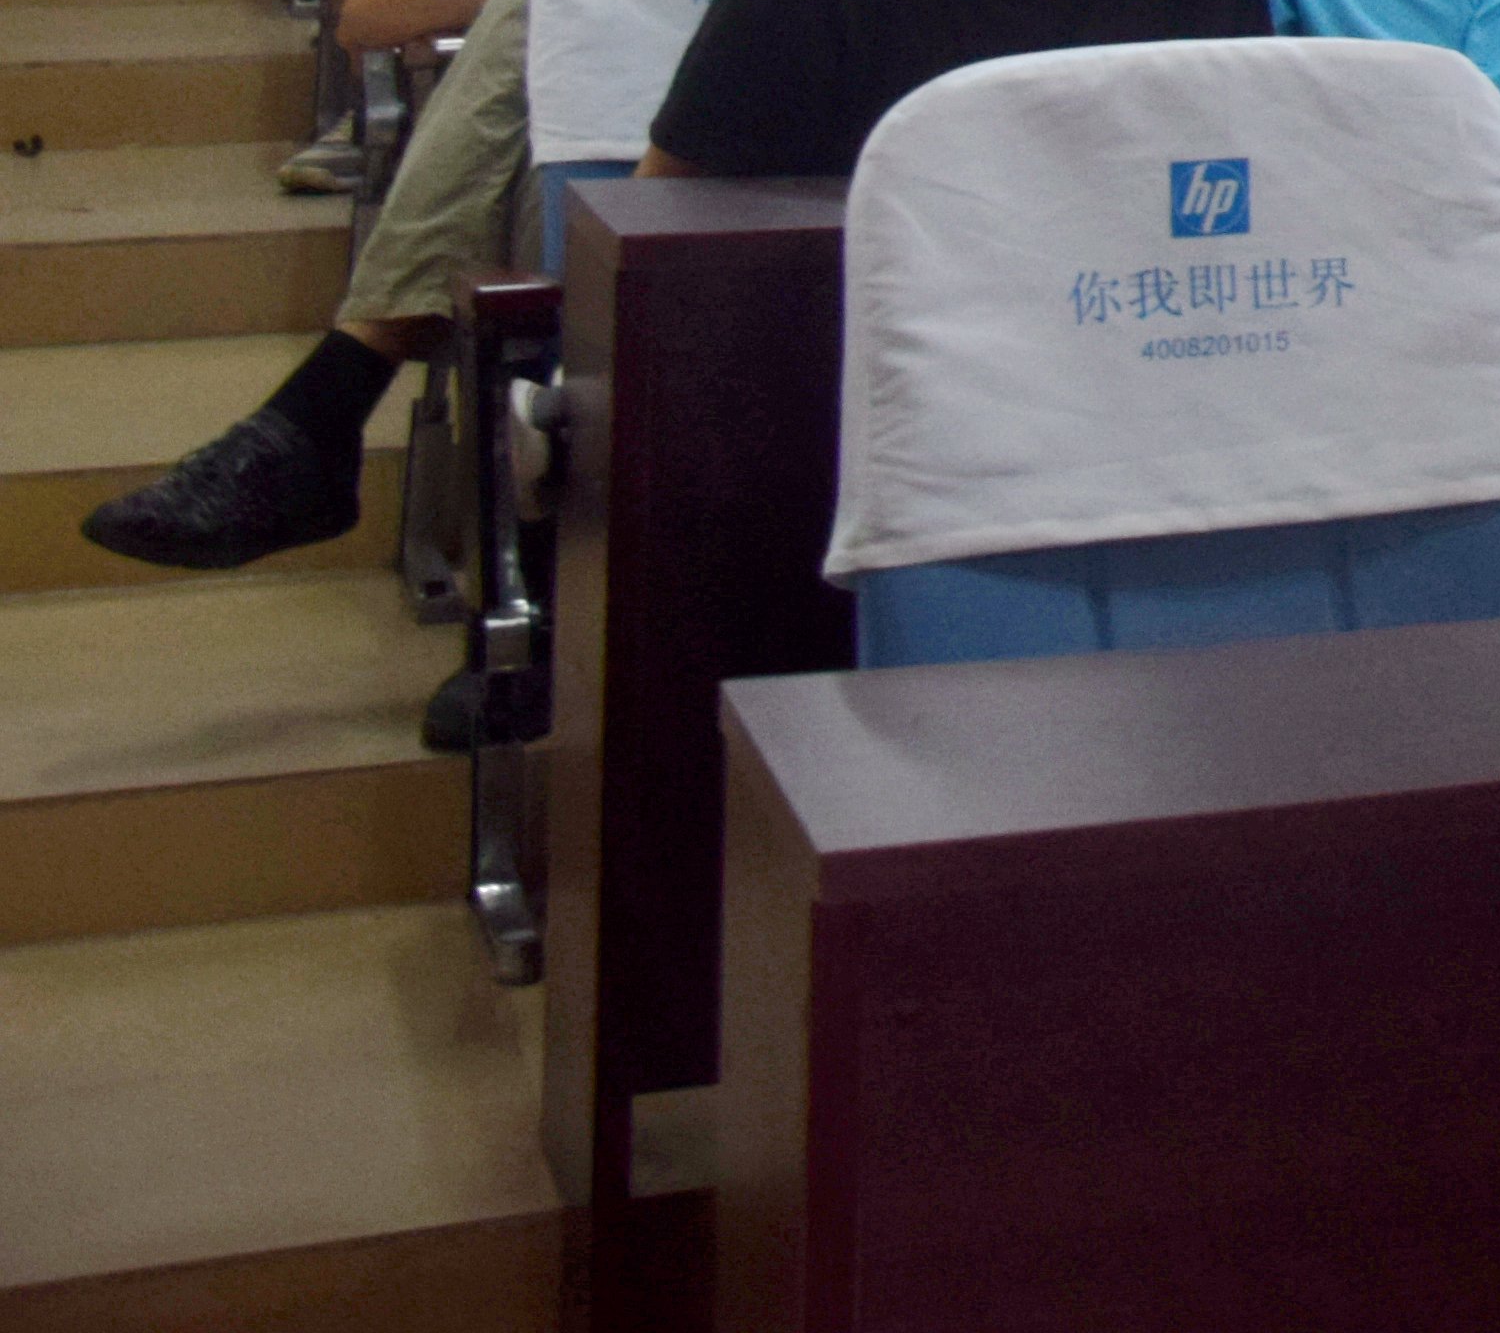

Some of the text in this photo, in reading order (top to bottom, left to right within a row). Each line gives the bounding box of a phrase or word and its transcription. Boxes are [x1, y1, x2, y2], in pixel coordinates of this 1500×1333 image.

[1182, 160, 1239, 233] hp
[1068, 256, 1356, 326] 你我即世界
[1141, 331, 1290, 360] 4008201015
